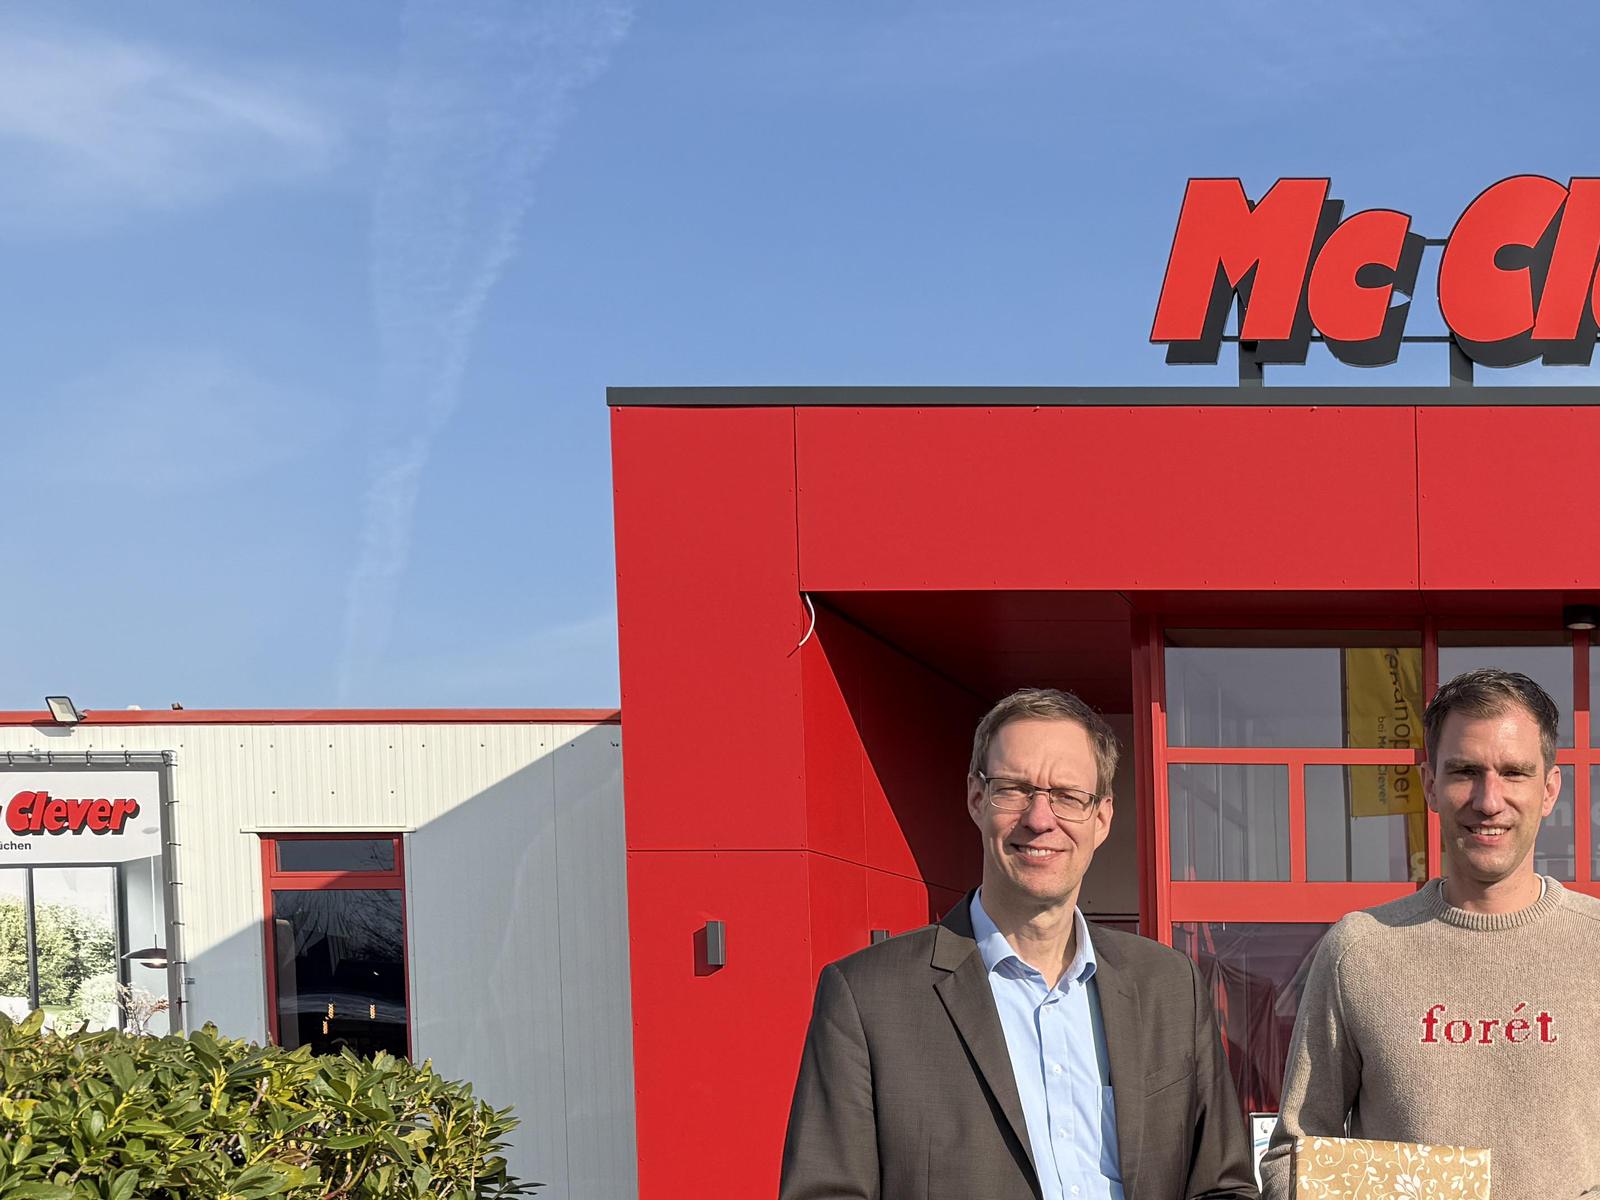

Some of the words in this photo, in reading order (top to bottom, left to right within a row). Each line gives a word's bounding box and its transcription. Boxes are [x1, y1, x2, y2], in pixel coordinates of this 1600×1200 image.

[1149, 176, 1425, 365] Mc
[5, 790, 141, 836] Clever
[1420, 1002, 1558, 1044] forét
